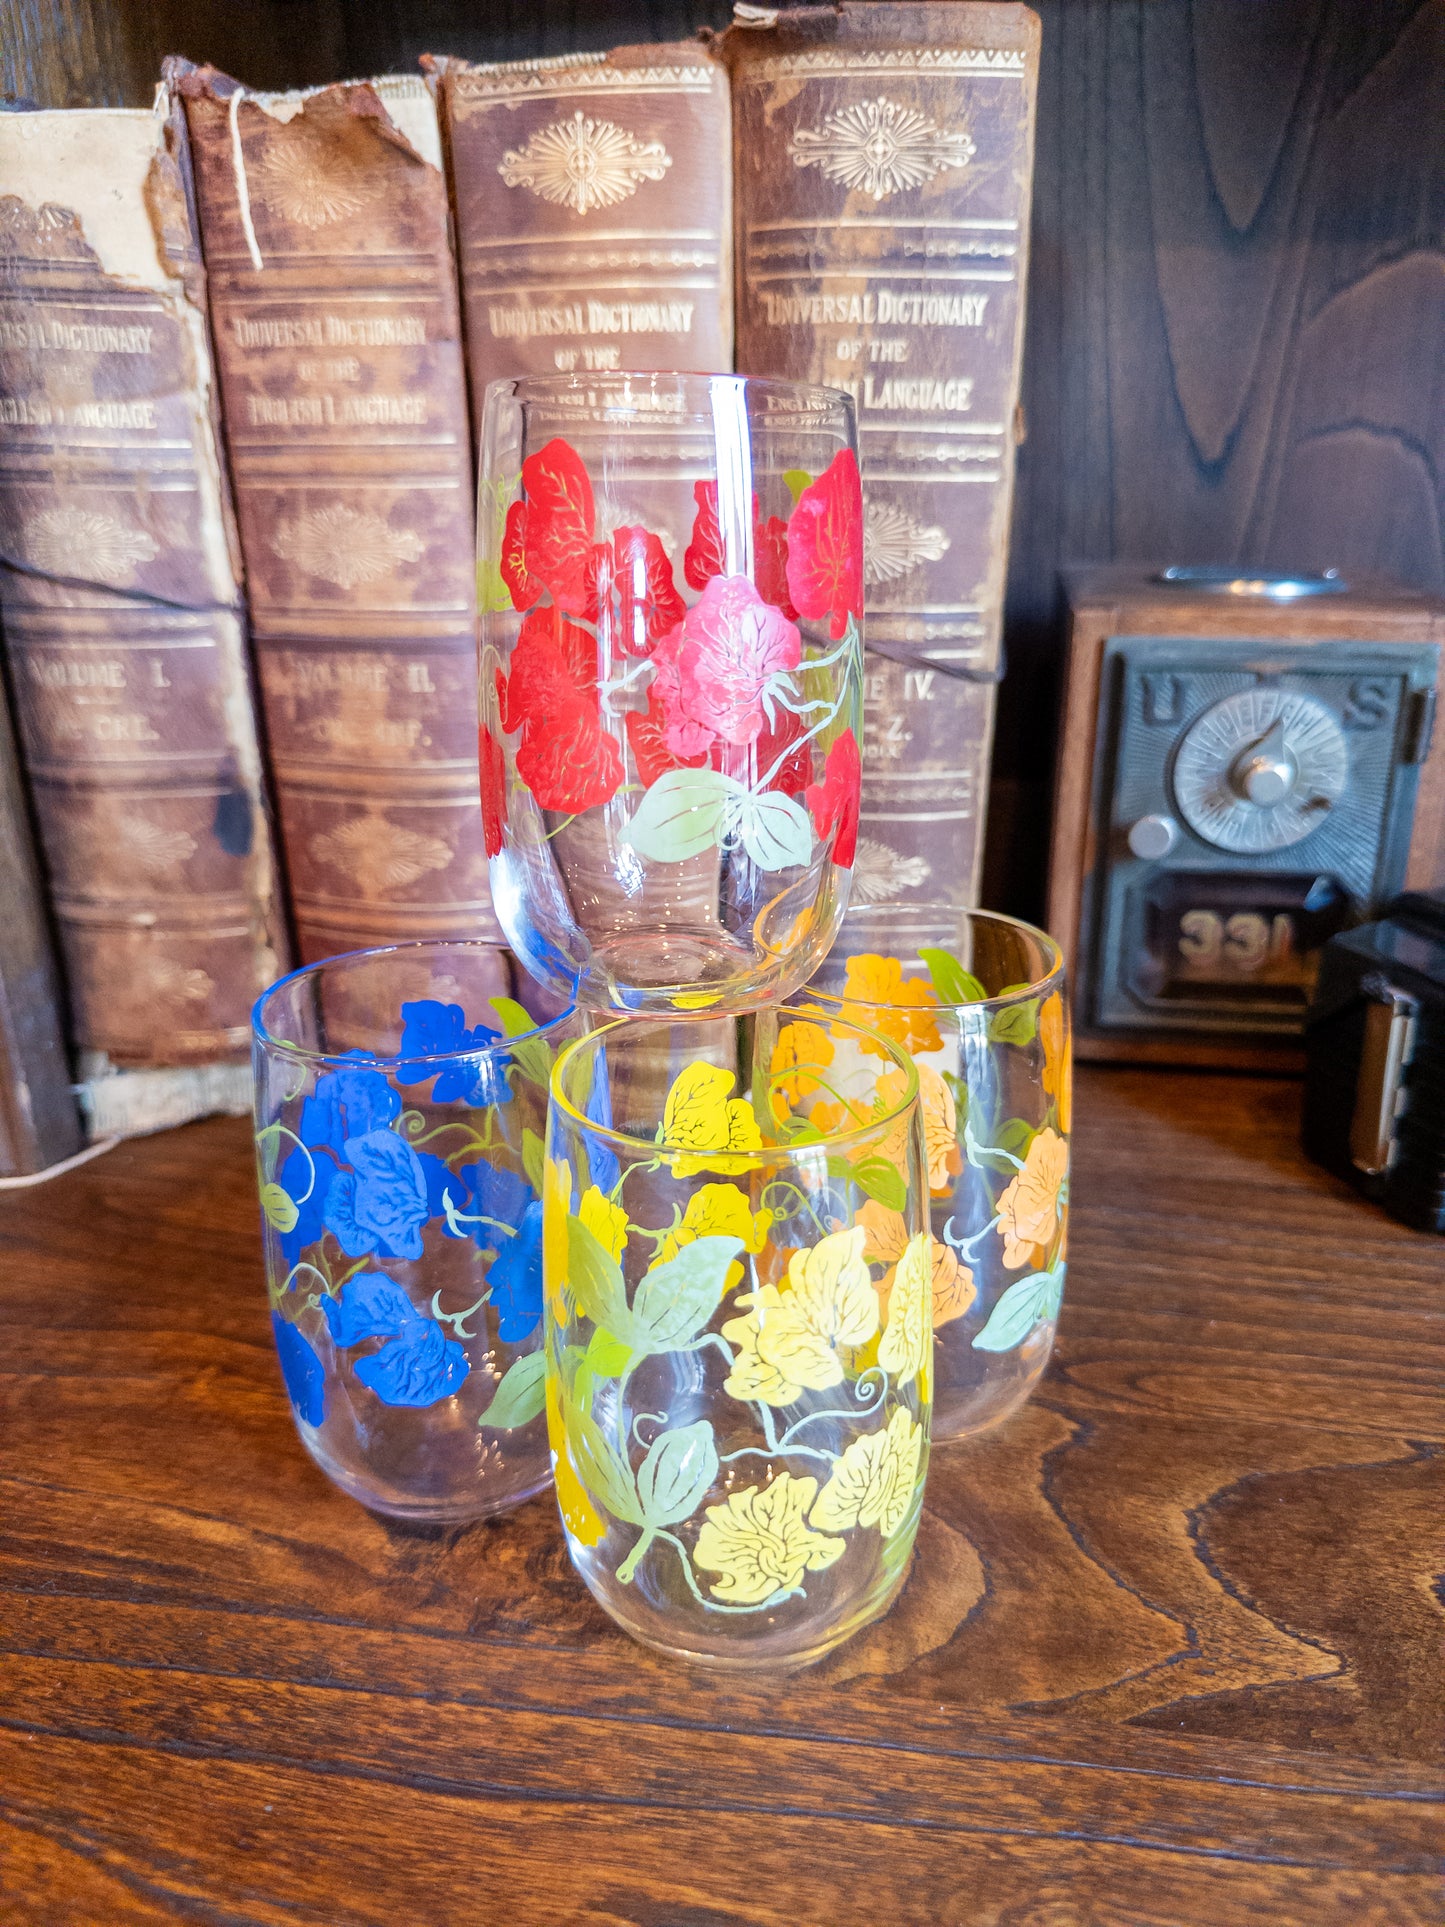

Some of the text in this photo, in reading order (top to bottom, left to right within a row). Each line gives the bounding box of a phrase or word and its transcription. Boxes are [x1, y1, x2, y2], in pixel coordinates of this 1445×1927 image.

[489, 300, 694, 338] UNIVERSAL DICTIONARY
[766, 290, 988, 327] UNIVERSAL DICTIONARY
[51, 319, 152, 354] DICTIONARY
[232, 315, 427, 347] UNIVERSAL DICTIONARY
[837, 338, 910, 362] OF THE
[863, 374, 976, 412] LANGUAGE
[904, 668, 936, 700] IV.
